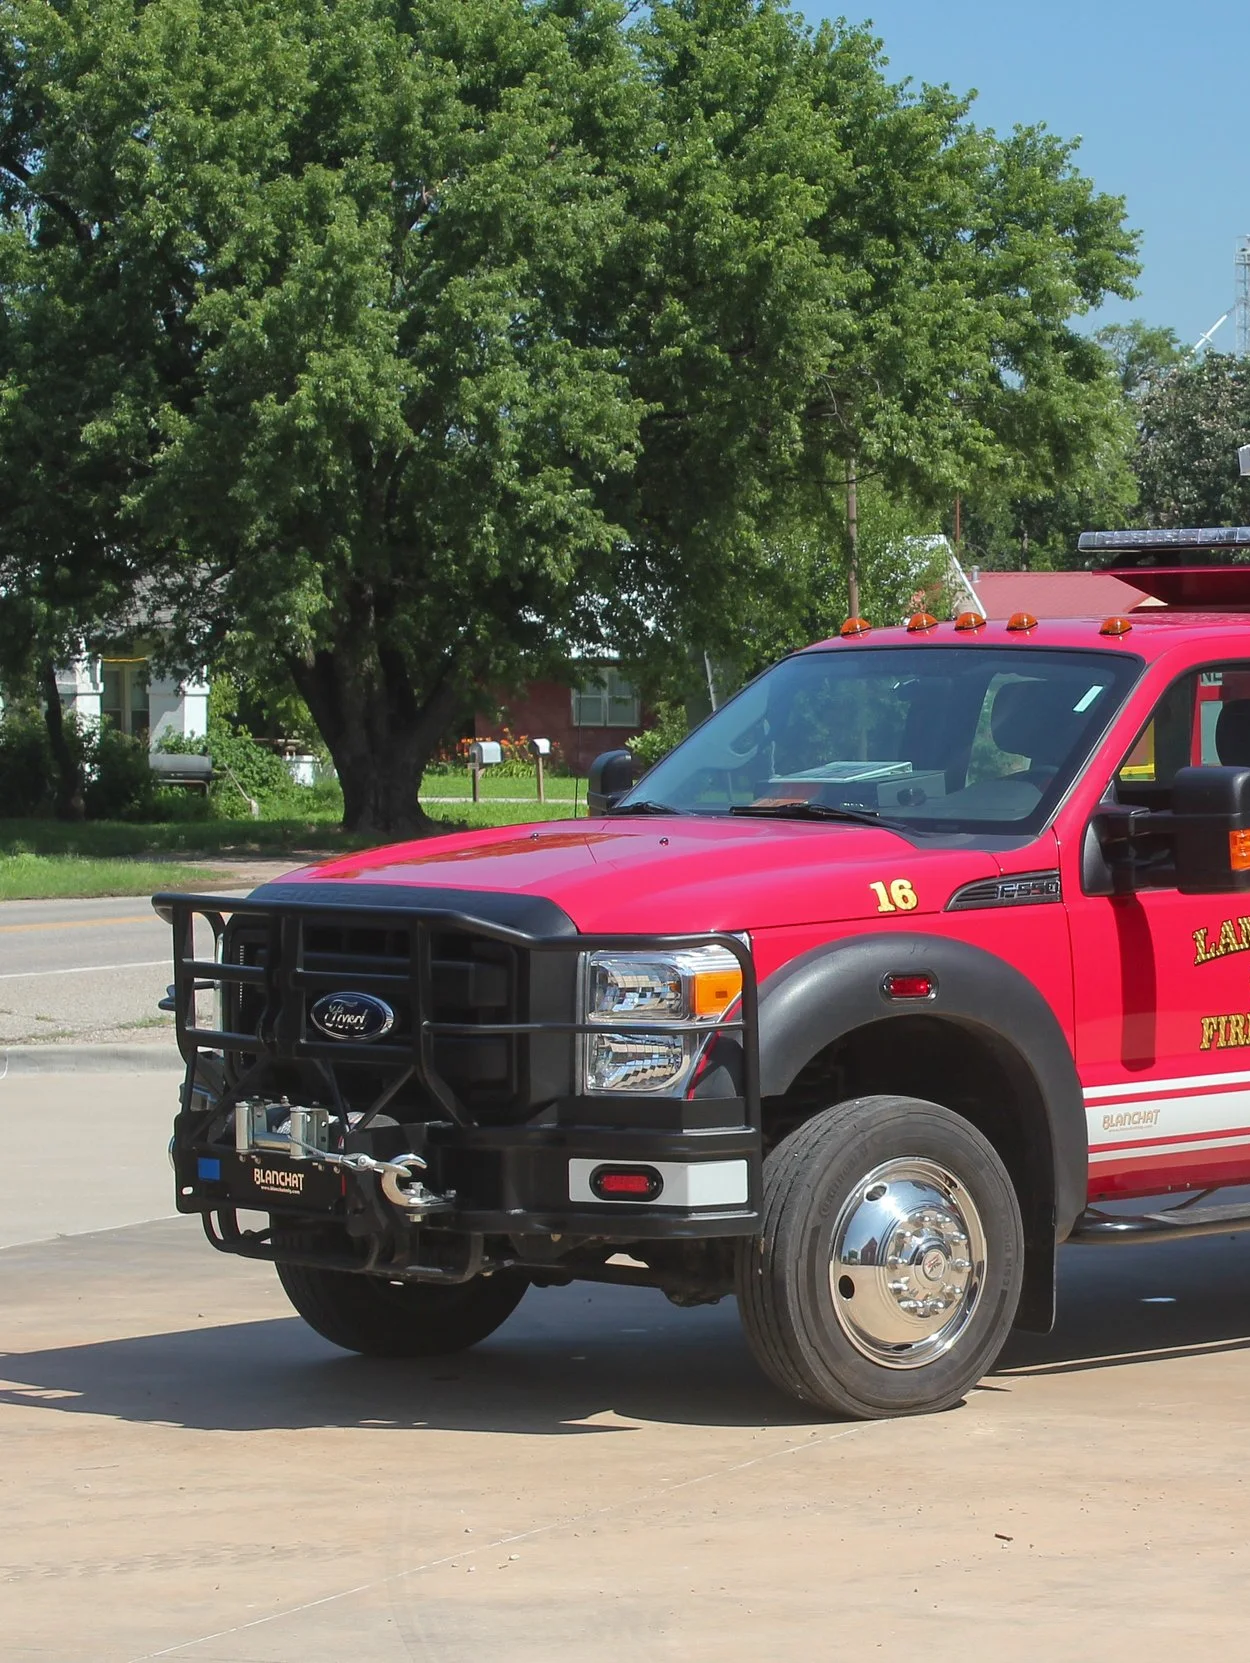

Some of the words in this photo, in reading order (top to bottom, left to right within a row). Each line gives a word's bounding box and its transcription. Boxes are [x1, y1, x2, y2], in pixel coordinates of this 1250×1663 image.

[869, 878, 918, 913] 16
[324, 999, 368, 1030] Ford
[1103, 1109, 1160, 1130] BLANCHAT
[254, 1168, 304, 1191] BLANCHAT
